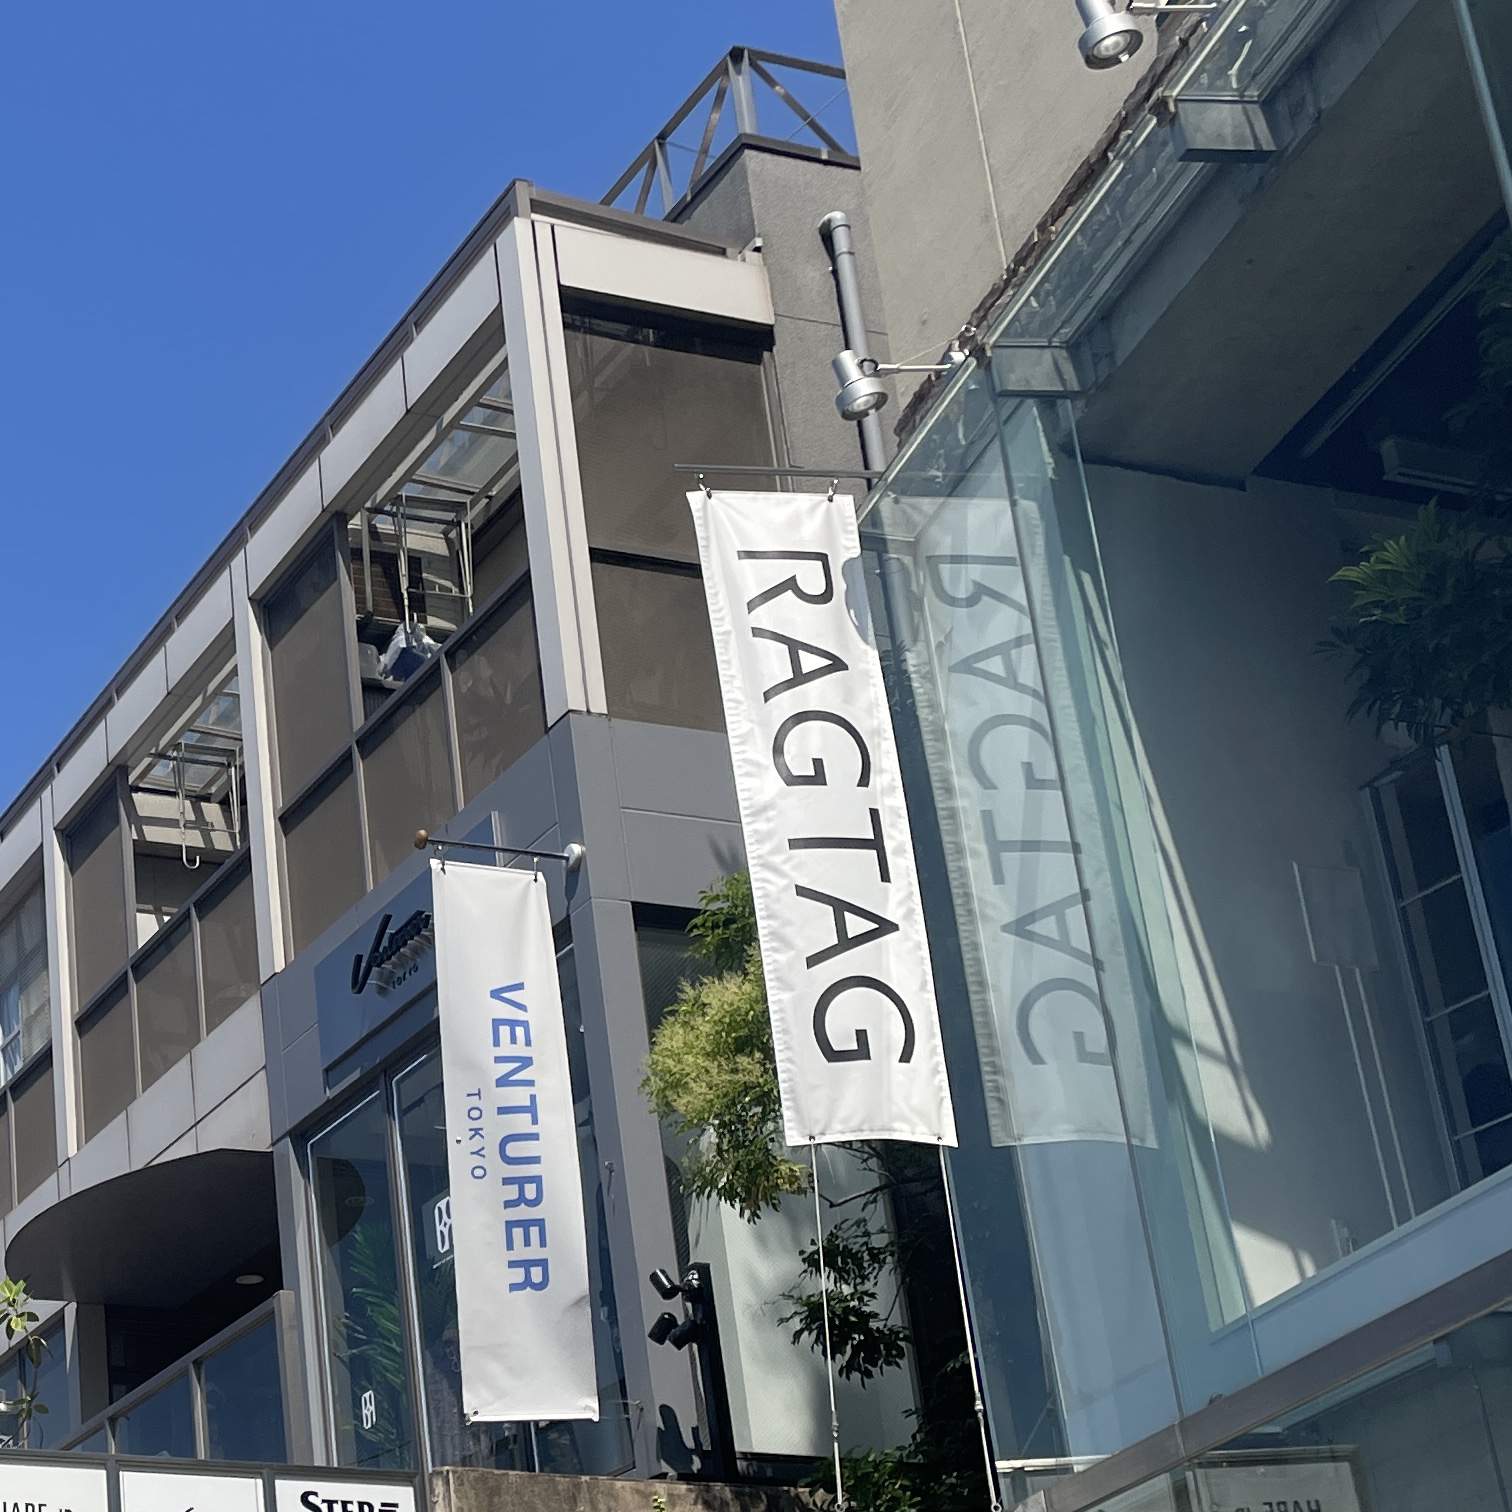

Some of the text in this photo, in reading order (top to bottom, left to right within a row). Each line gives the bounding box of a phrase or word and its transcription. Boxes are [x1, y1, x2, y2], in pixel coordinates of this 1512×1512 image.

[735, 548, 915, 1065] RAGTAG
[465, 1087, 487, 1181] TOKYO
[489, 981, 551, 1294] VENTURER
